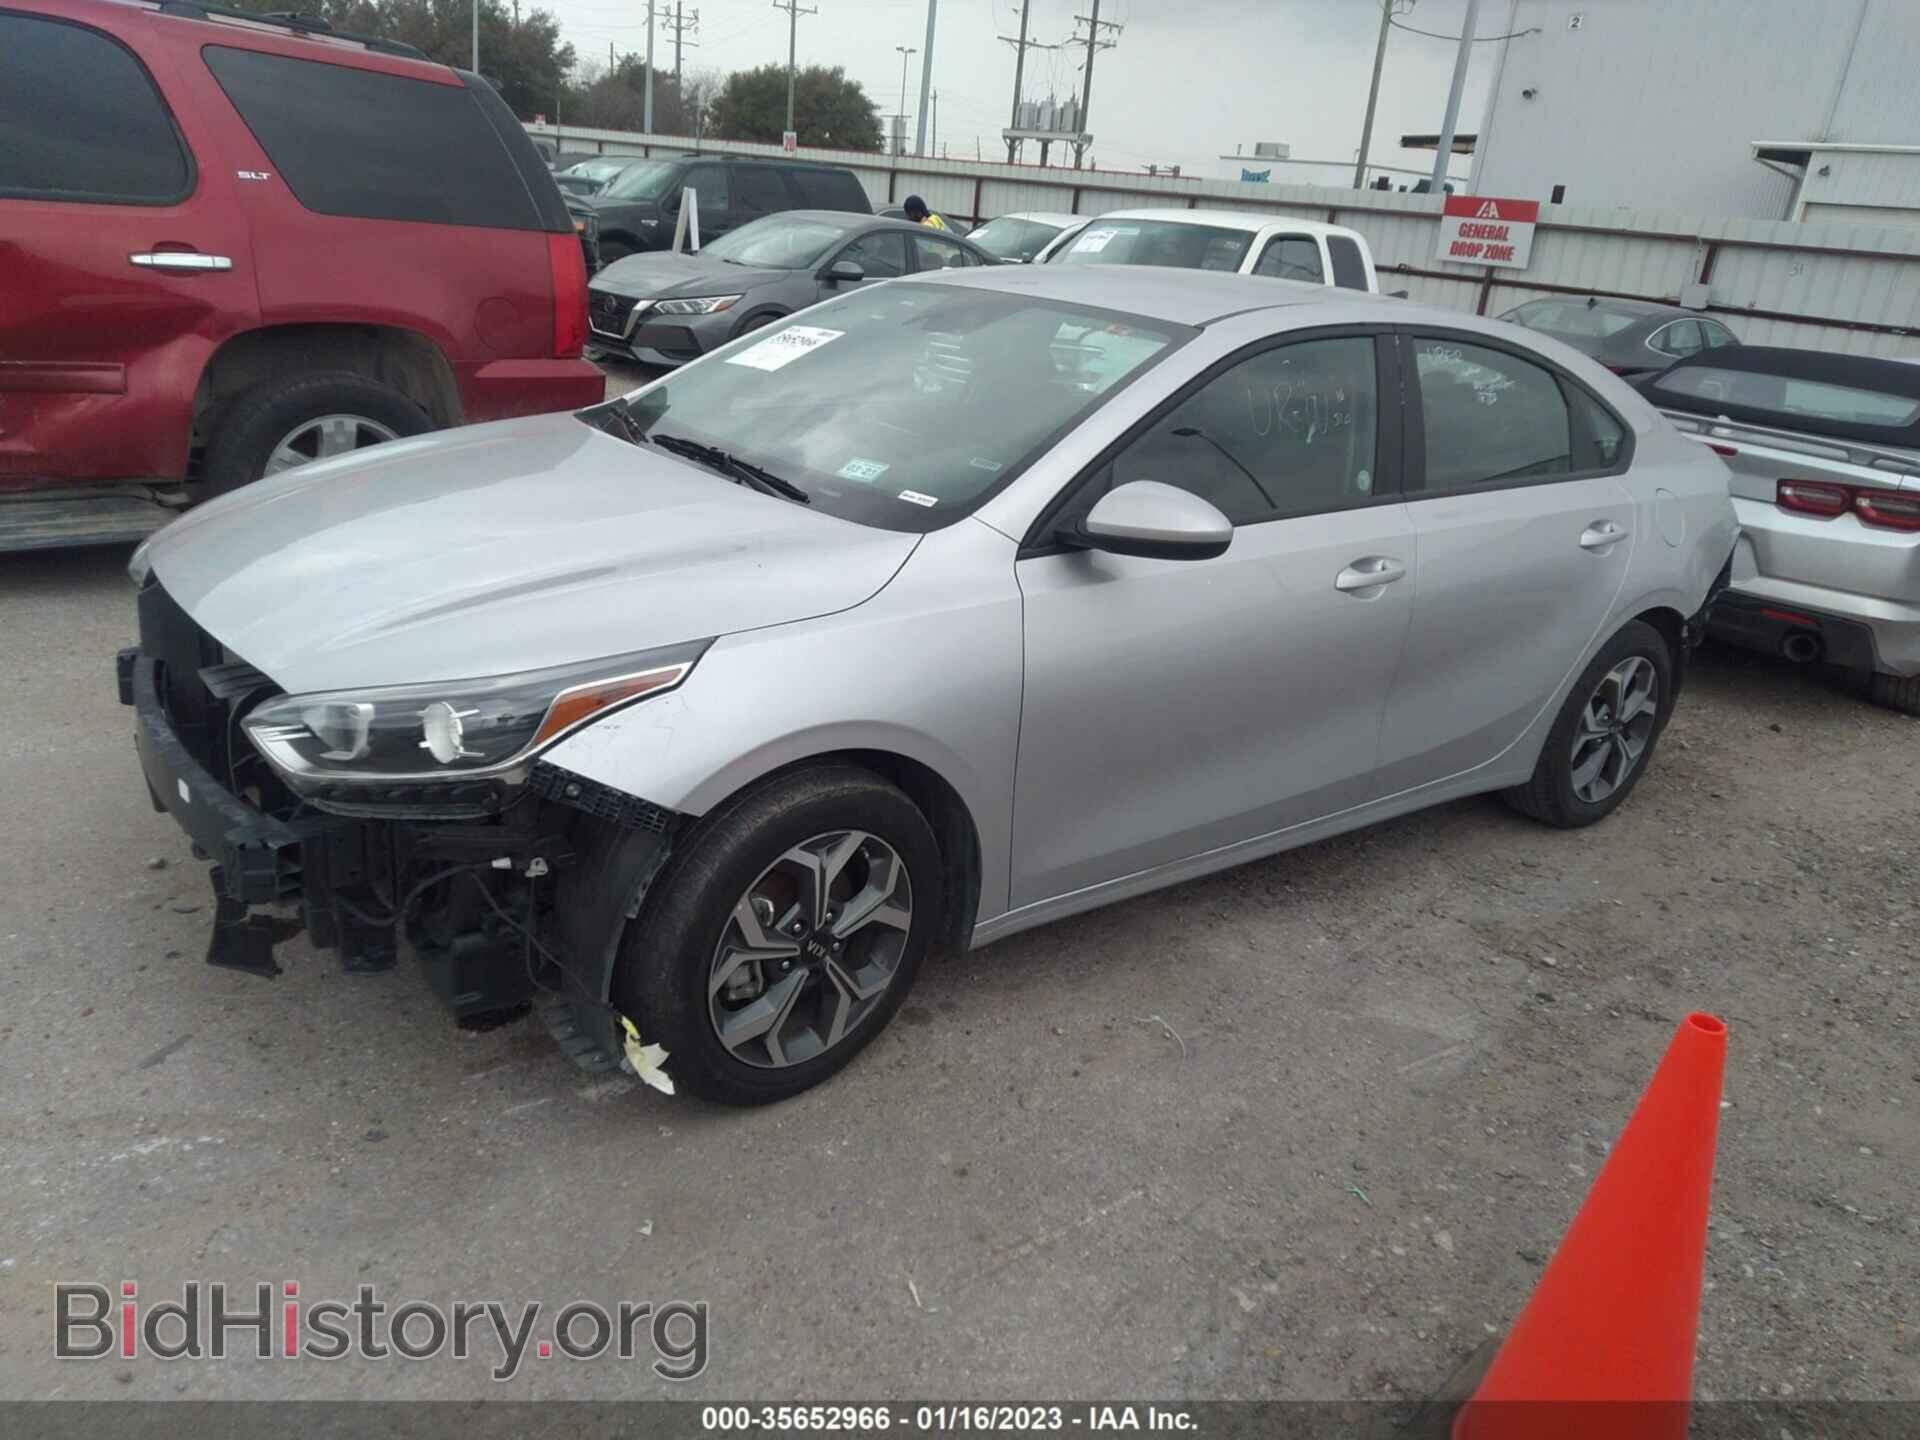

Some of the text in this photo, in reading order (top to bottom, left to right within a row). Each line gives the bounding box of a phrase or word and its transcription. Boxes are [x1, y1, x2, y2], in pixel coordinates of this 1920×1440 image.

[238, 171, 271, 180] SLT
[1458, 222, 1510, 241] GENERAL
[1449, 240, 1515, 262] DROP ZONE
